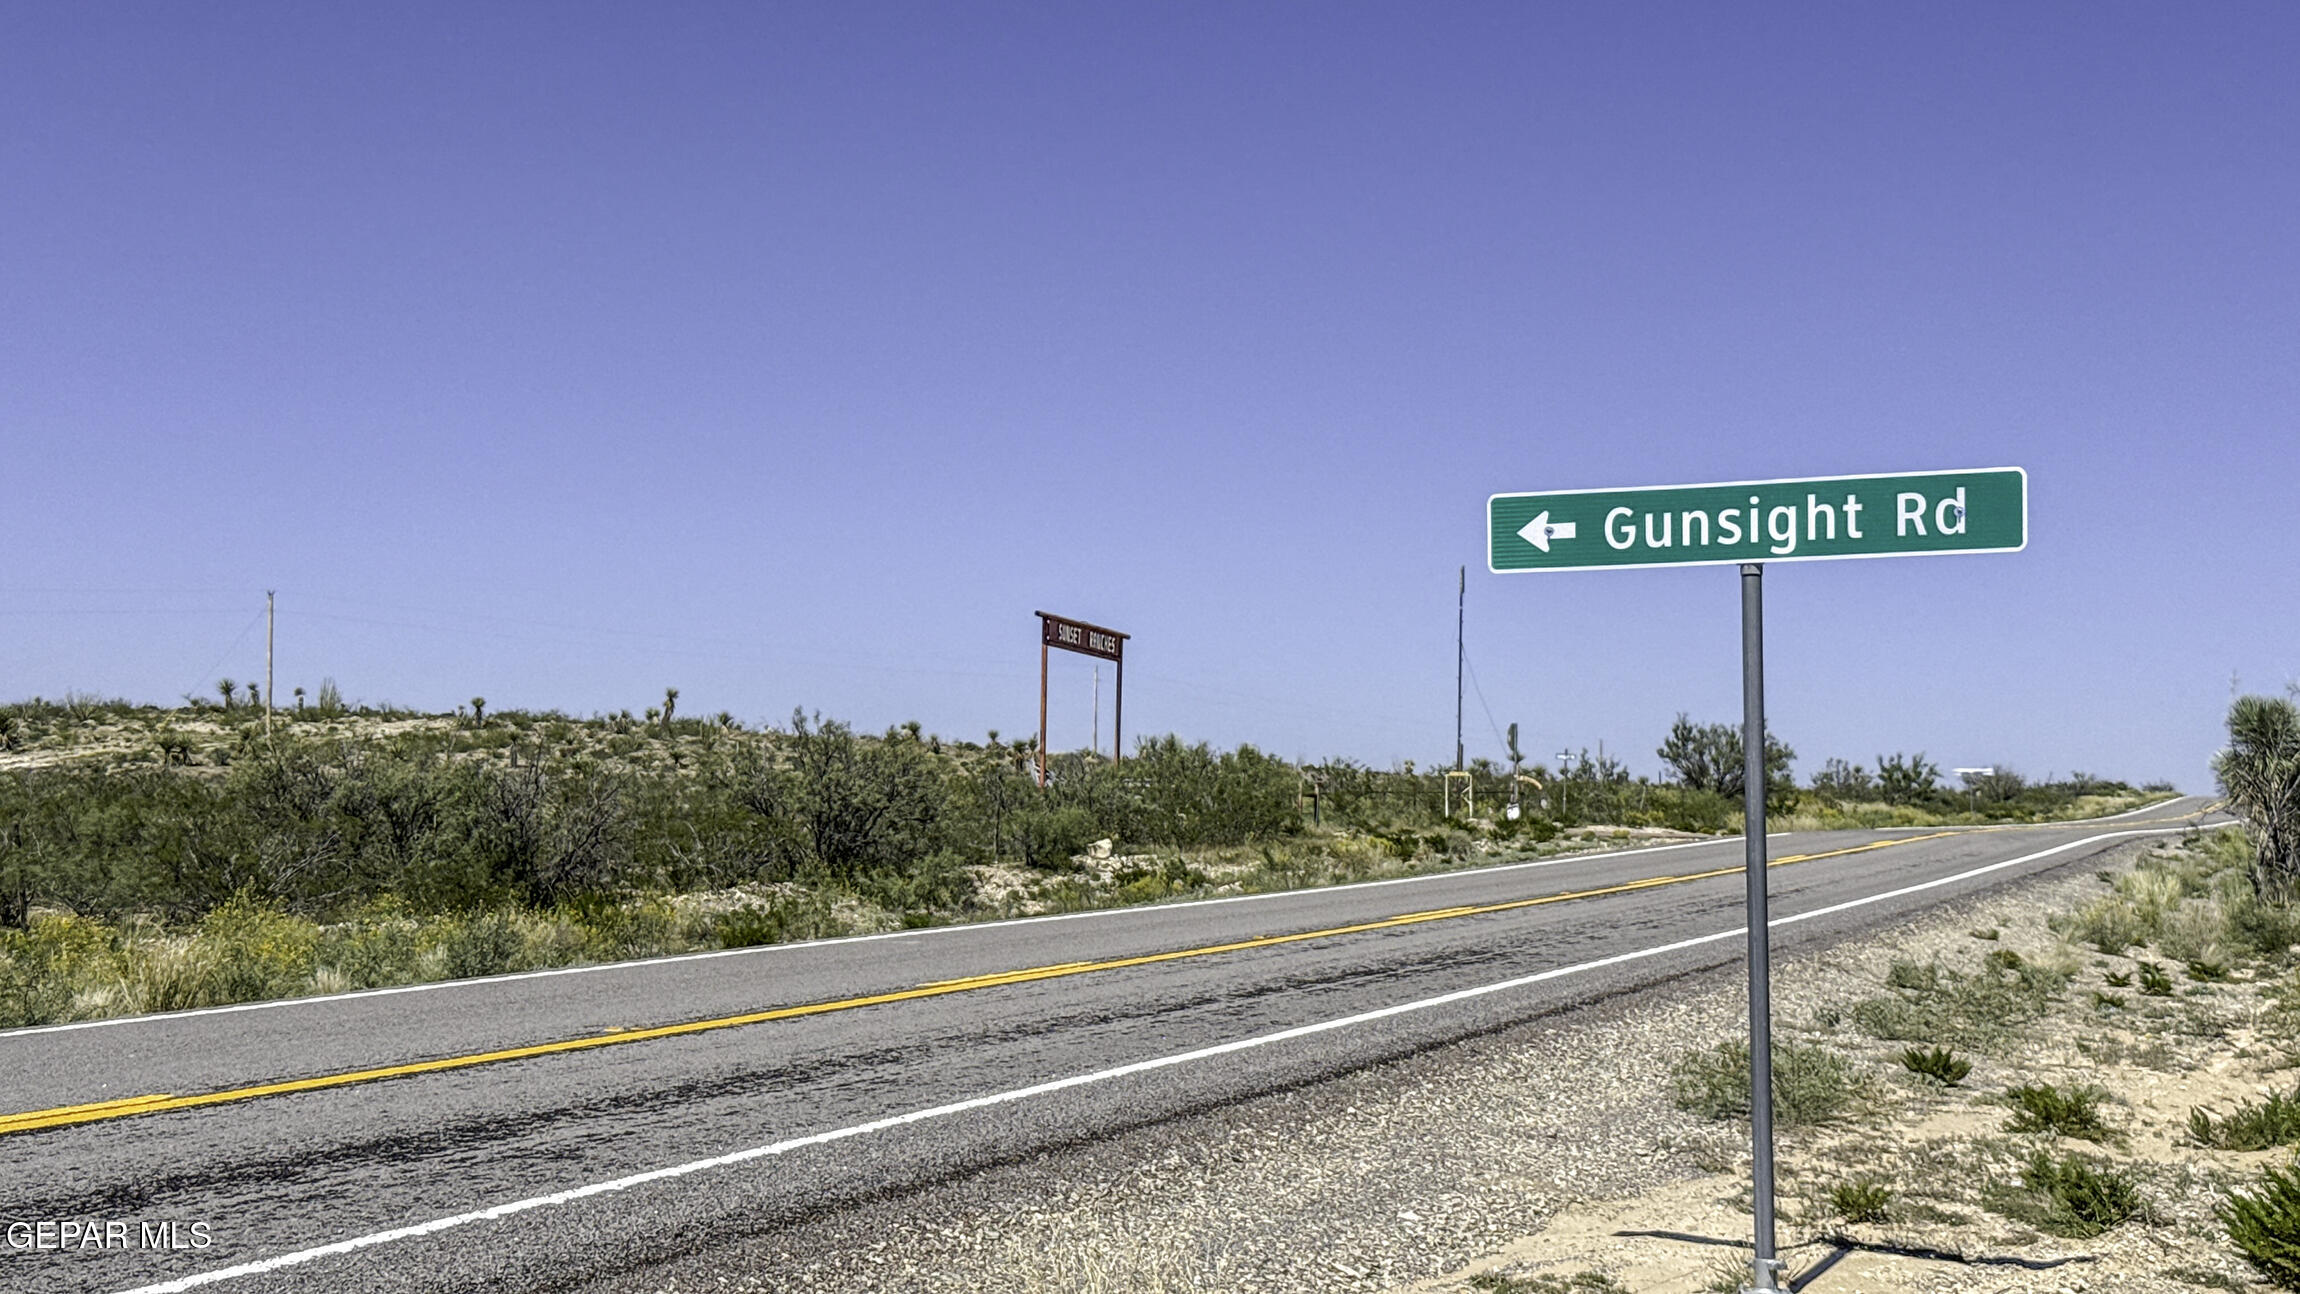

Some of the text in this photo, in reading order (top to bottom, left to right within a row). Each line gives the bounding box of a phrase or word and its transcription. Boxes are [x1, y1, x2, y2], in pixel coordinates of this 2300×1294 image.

[1603, 487, 1967, 556] Gunsight Rd
[1058, 623, 1116, 653] SUNSET RANCHES
